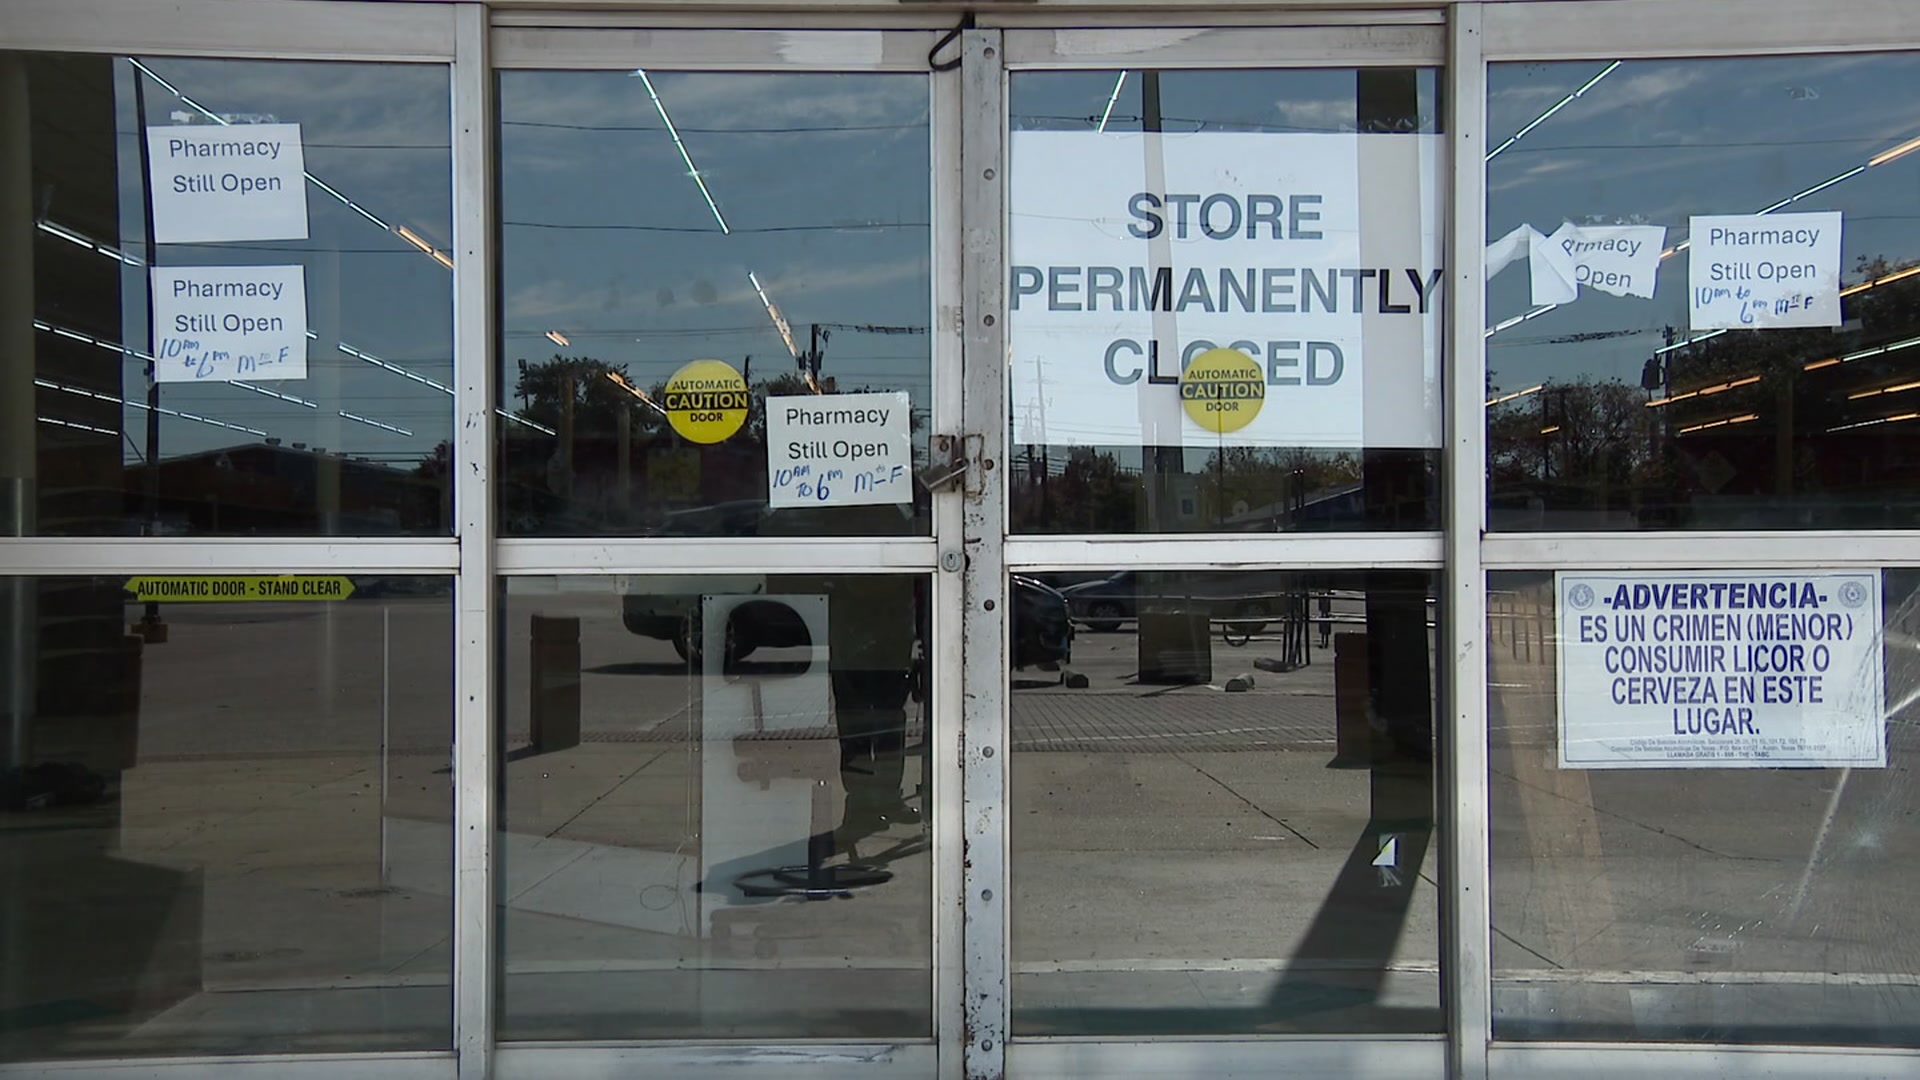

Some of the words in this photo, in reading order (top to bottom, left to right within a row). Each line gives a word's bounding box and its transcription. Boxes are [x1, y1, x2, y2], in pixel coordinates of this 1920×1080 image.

[169, 139, 281, 159] Pharmacy
[173, 174, 216, 193] Still
[221, 173, 282, 195] Open
[1127, 191, 1323, 240] STORE
[1709, 227, 1820, 250] Pharmacy
[1710, 261, 1751, 282] Still
[1757, 261, 1817, 284] Open
[173, 279, 283, 300] Pharmacy
[1010, 265, 1443, 314] PERMANENTLY
[175, 314, 217, 333] Still
[223, 313, 283, 335] Open
[672, 378, 741, 390] AUTOMATIC
[1188, 368, 1257, 380] AUTOMATIC
[665, 391, 748, 409] CAUTION
[1182, 382, 1264, 399] CAUTION
[690, 411, 724, 422] DOOR
[786, 407, 889, 427] Pharmacy
[1205, 402, 1240, 412] DOOR
[788, 441, 828, 460] Still
[833, 440, 889, 462] Open
[137, 580, 208, 596] AUTOMATIC
[212, 580, 246, 595] DOOR
[258, 580, 298, 595] STAND
[302, 580, 341, 595] CLEAR
[1603, 582, 1828, 610] -ADVERTENCIA-
[1580, 614, 1608, 643] ES
[1615, 614, 1645, 643] UN
[1653, 613, 1741, 642] CRIMEN
[1747, 612, 1853, 642] (MENOR)
[1605, 645, 1726, 674] CONSUMIR
[1734, 644, 1804, 673] LICOR
[1812, 644, 1830, 673] O
[1612, 676, 1718, 705] CERVEZA
[1725, 676, 1756, 704] EN
[1763, 675, 1823, 704] ESTE
[1673, 707, 1760, 736] LUGAR.
